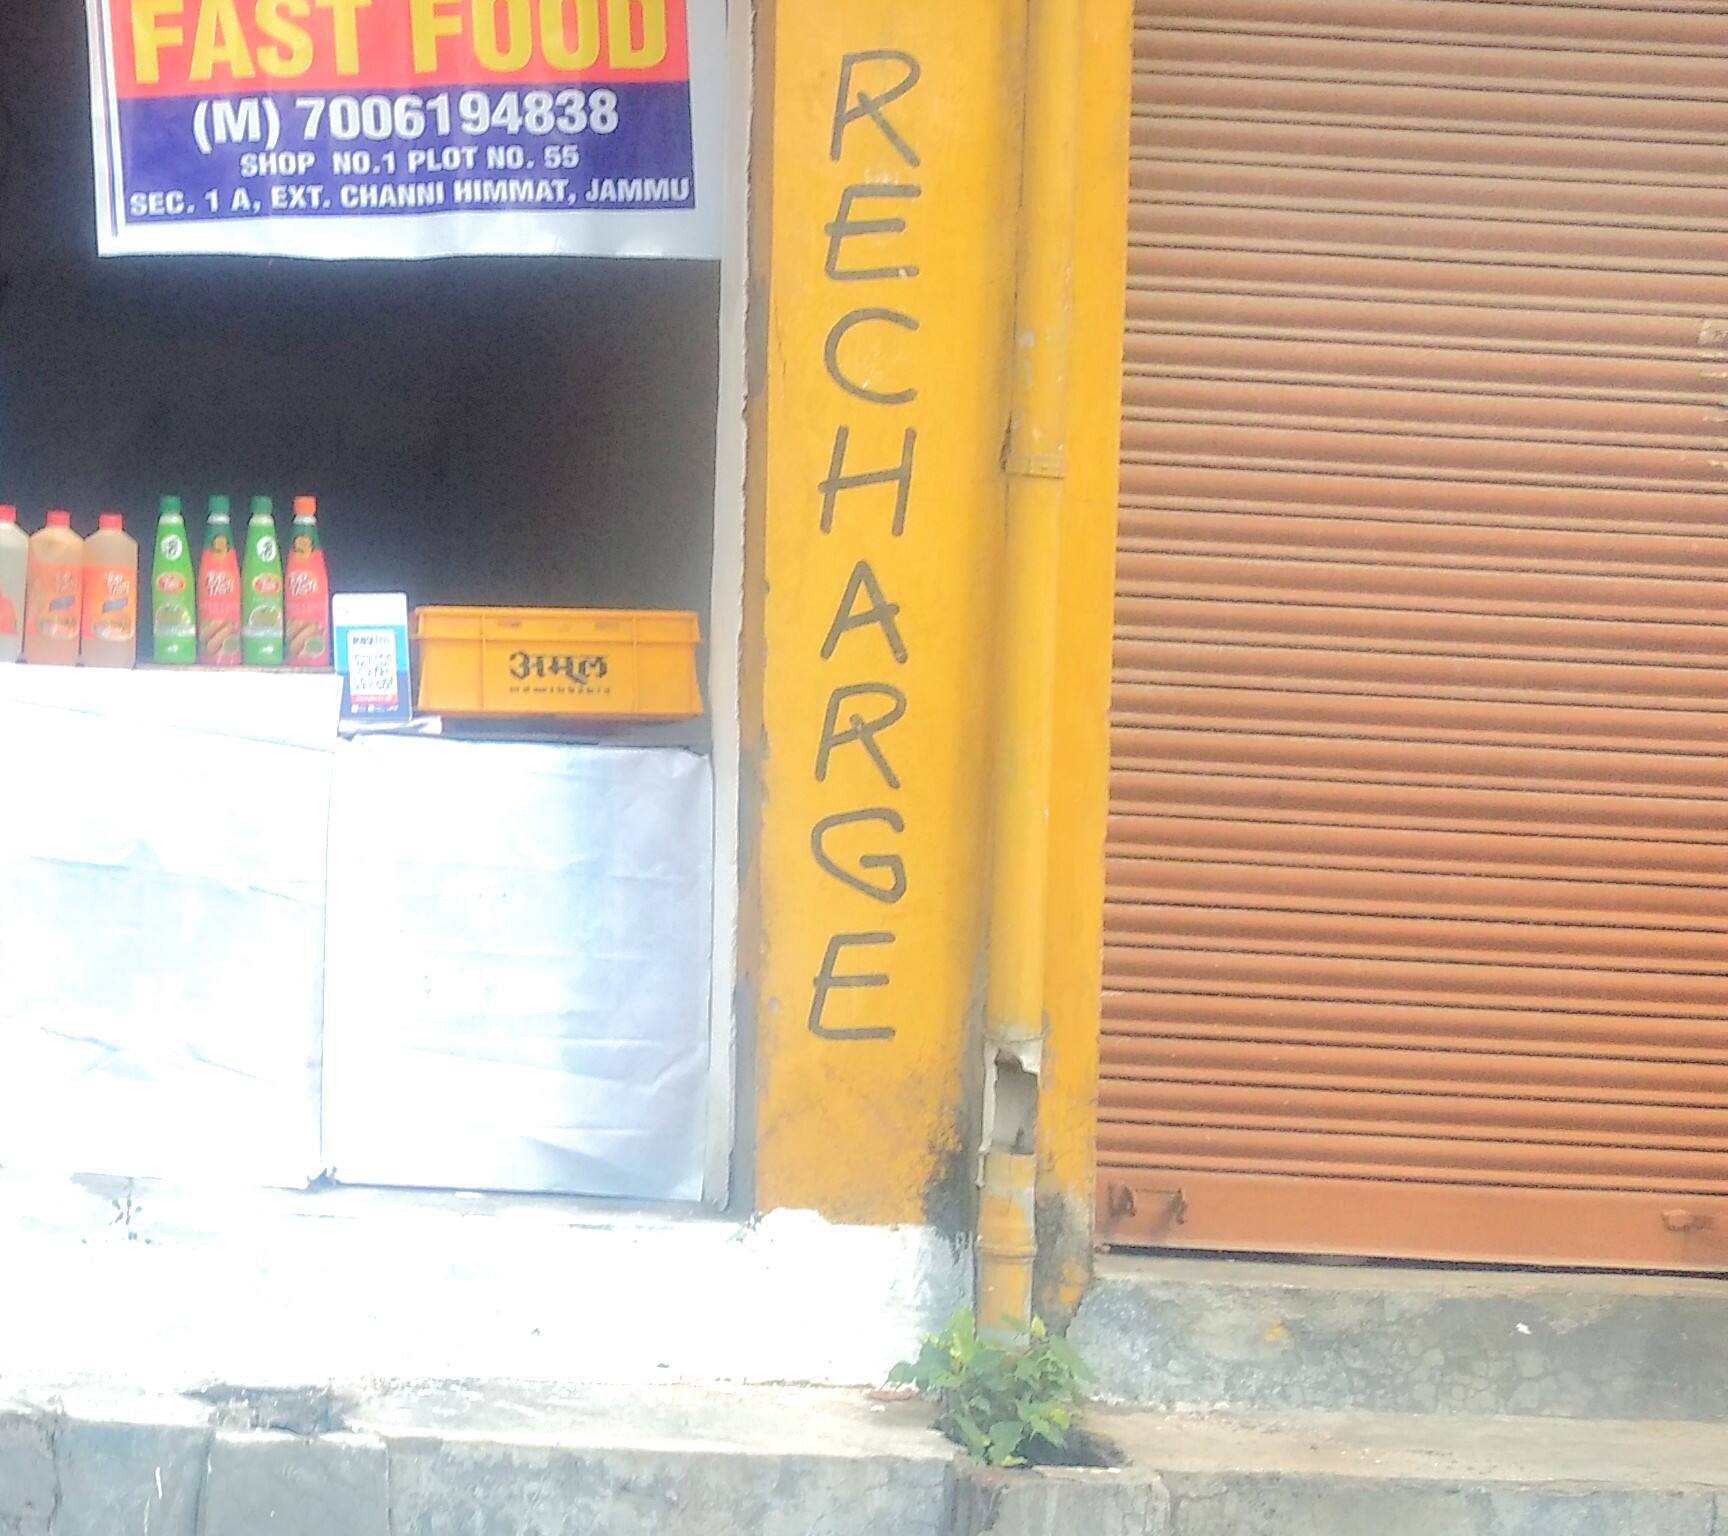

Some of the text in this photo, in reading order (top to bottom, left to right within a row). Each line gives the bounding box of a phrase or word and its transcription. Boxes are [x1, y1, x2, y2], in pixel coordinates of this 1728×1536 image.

[192, 88, 620, 155] (M) 7006194838
[239, 144, 580, 178] SHOP NO.1 PLOT NO. 55
[129, 177, 691, 215] SEC. 1 A, EXT. CHANNI HIMMAT, JAMMU
[810, 49, 922, 1041] RECHARGE
